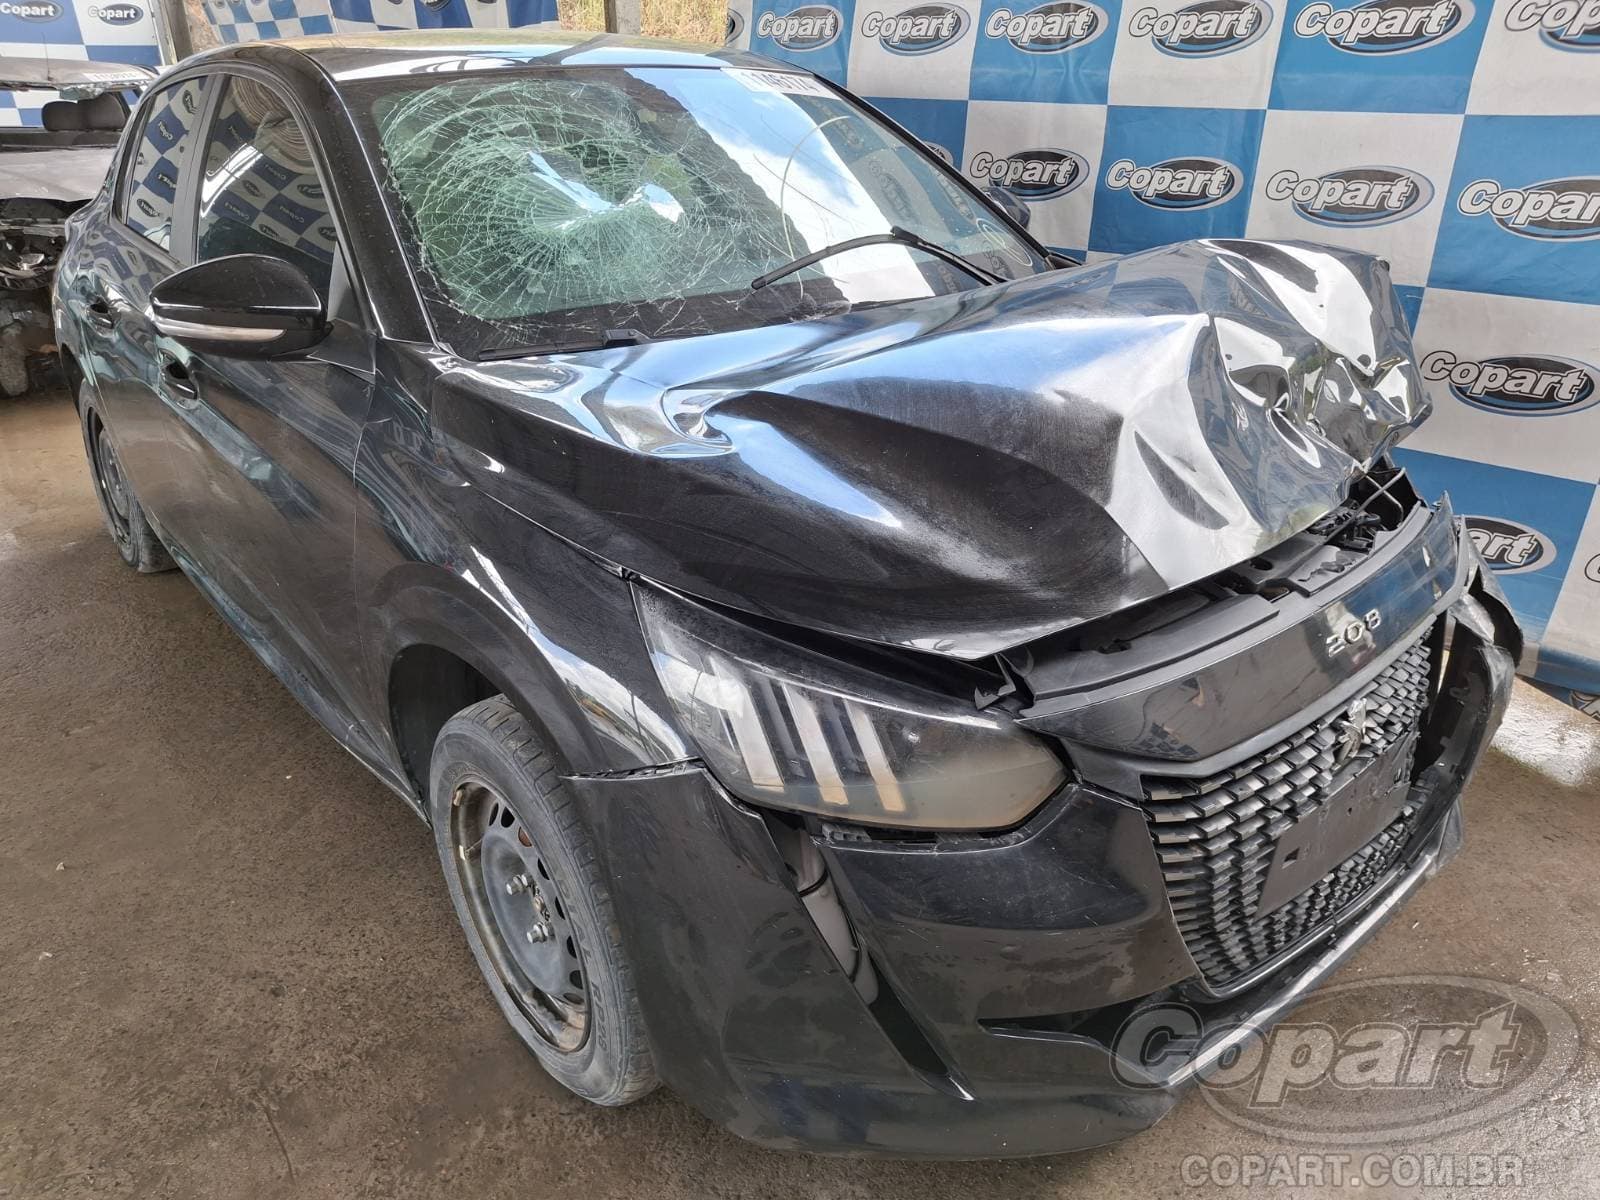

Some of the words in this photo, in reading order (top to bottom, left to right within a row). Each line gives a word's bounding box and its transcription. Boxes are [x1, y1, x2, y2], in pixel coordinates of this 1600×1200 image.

[0, 2, 55, 17] Copart
[88, 5, 136, 19] Copart
[758, 9, 835, 43] Copart
[861, 9, 957, 44] Copart
[985, 7, 1094, 46] Copart
[1128, 3, 1257, 46] Copart
[1294, 0, 1456, 46] Copart
[970, 151, 1076, 187] Copart
[1105, 159, 1231, 198] Copart
[1266, 169, 1416, 211] Copart
[1420, 350, 1588, 404] Copart
[1325, 608, 1381, 658] 208
